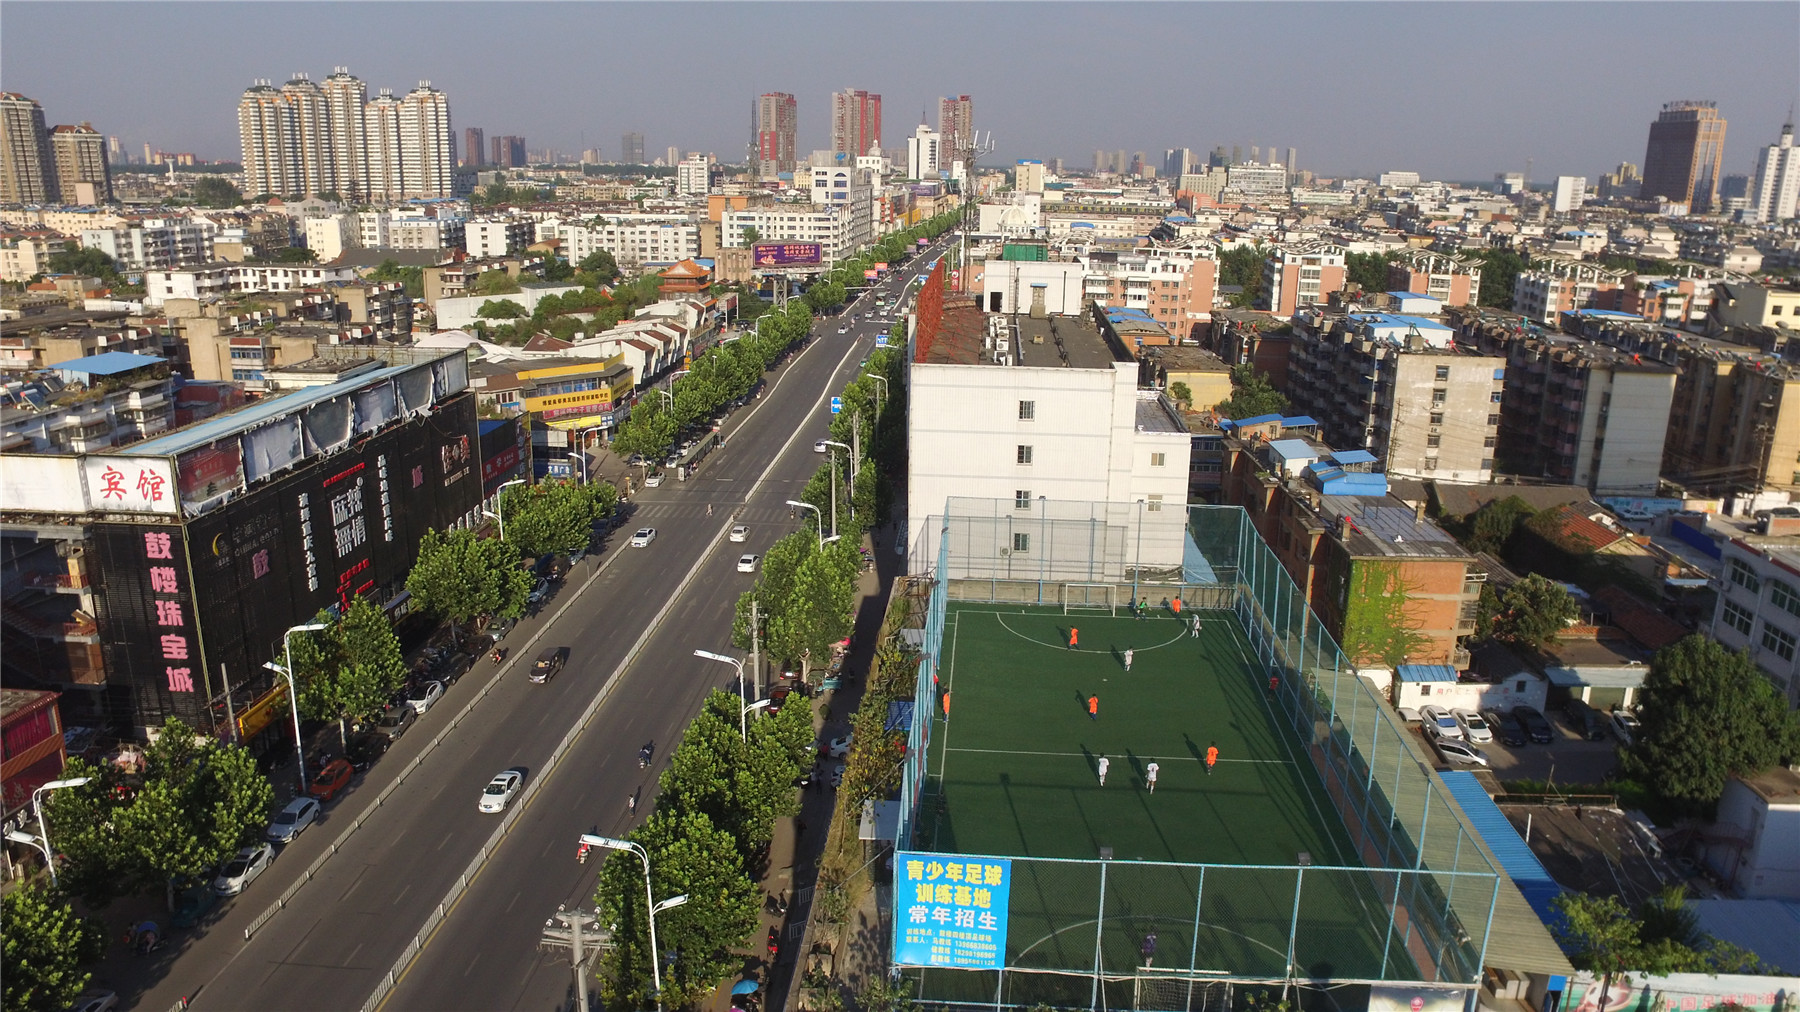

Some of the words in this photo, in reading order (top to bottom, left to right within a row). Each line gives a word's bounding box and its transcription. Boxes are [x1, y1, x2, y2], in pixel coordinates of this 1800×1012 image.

[100, 465, 165, 502] 宾馆
[330, 485, 363, 527] 麻辣
[144, 531, 193, 693] 鼓楼珠宝城
[906, 860, 1003, 886] 青少年足球
[915, 883, 992, 909] 训练基地
[908, 904, 998, 931] 常年招生
